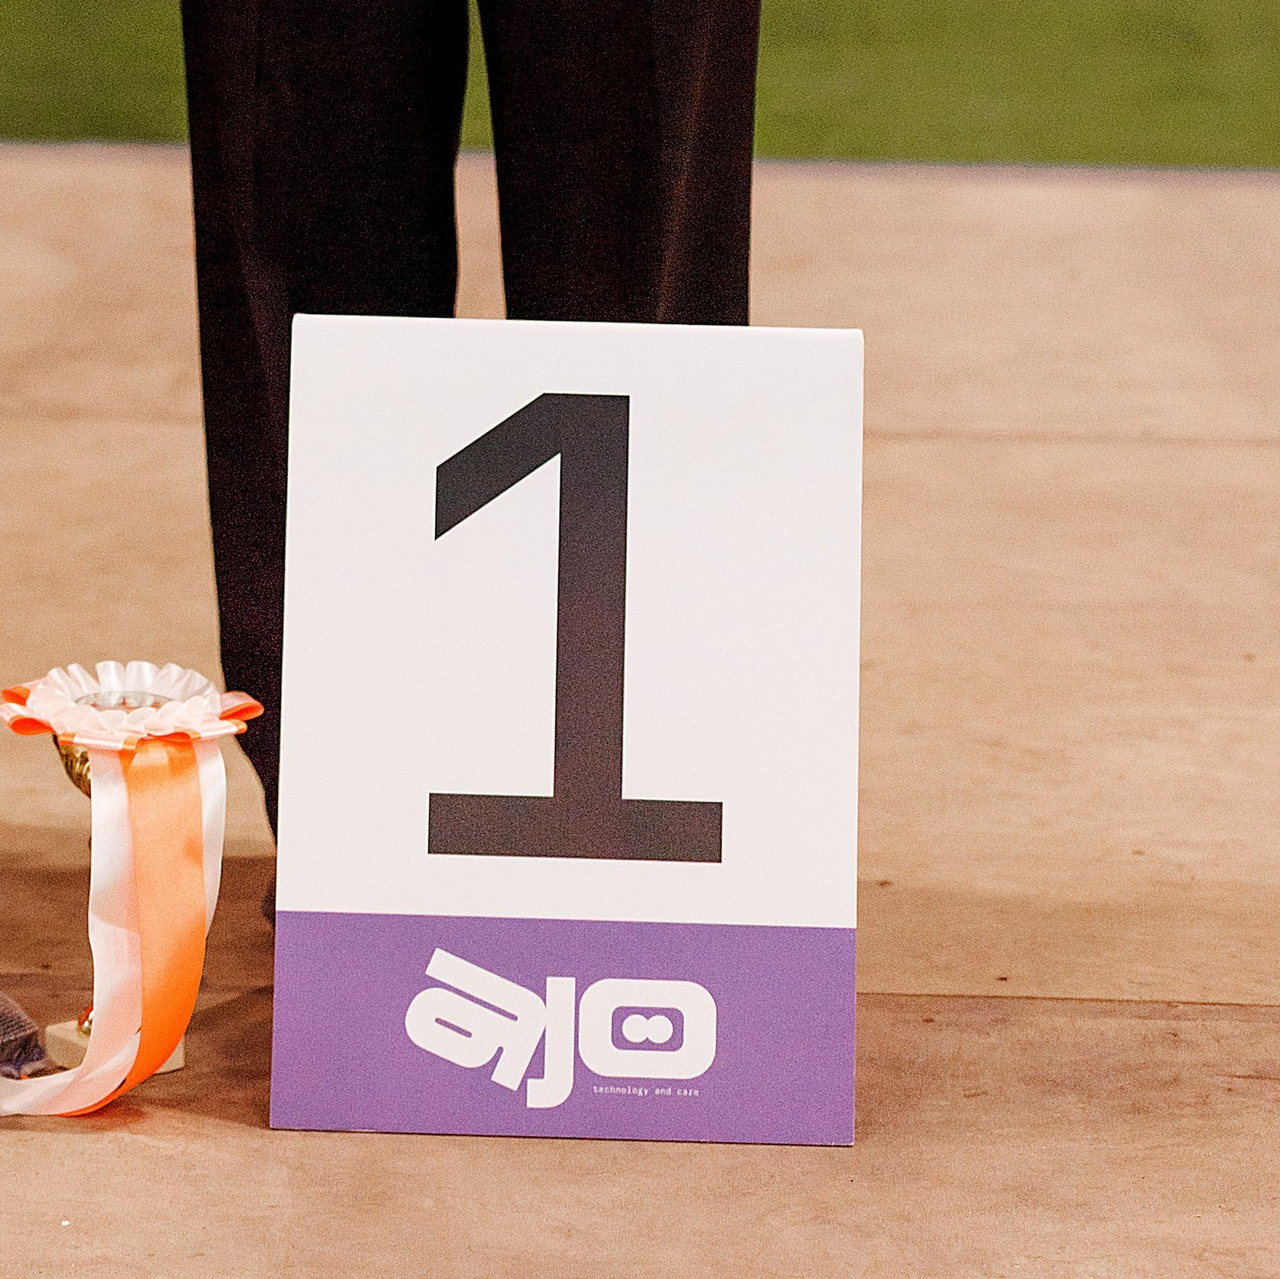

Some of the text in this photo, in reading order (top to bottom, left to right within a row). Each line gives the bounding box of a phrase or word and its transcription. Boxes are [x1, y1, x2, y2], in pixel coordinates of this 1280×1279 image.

[428, 393, 723, 863] 1
[593, 1085, 700, 1097] technology and care
